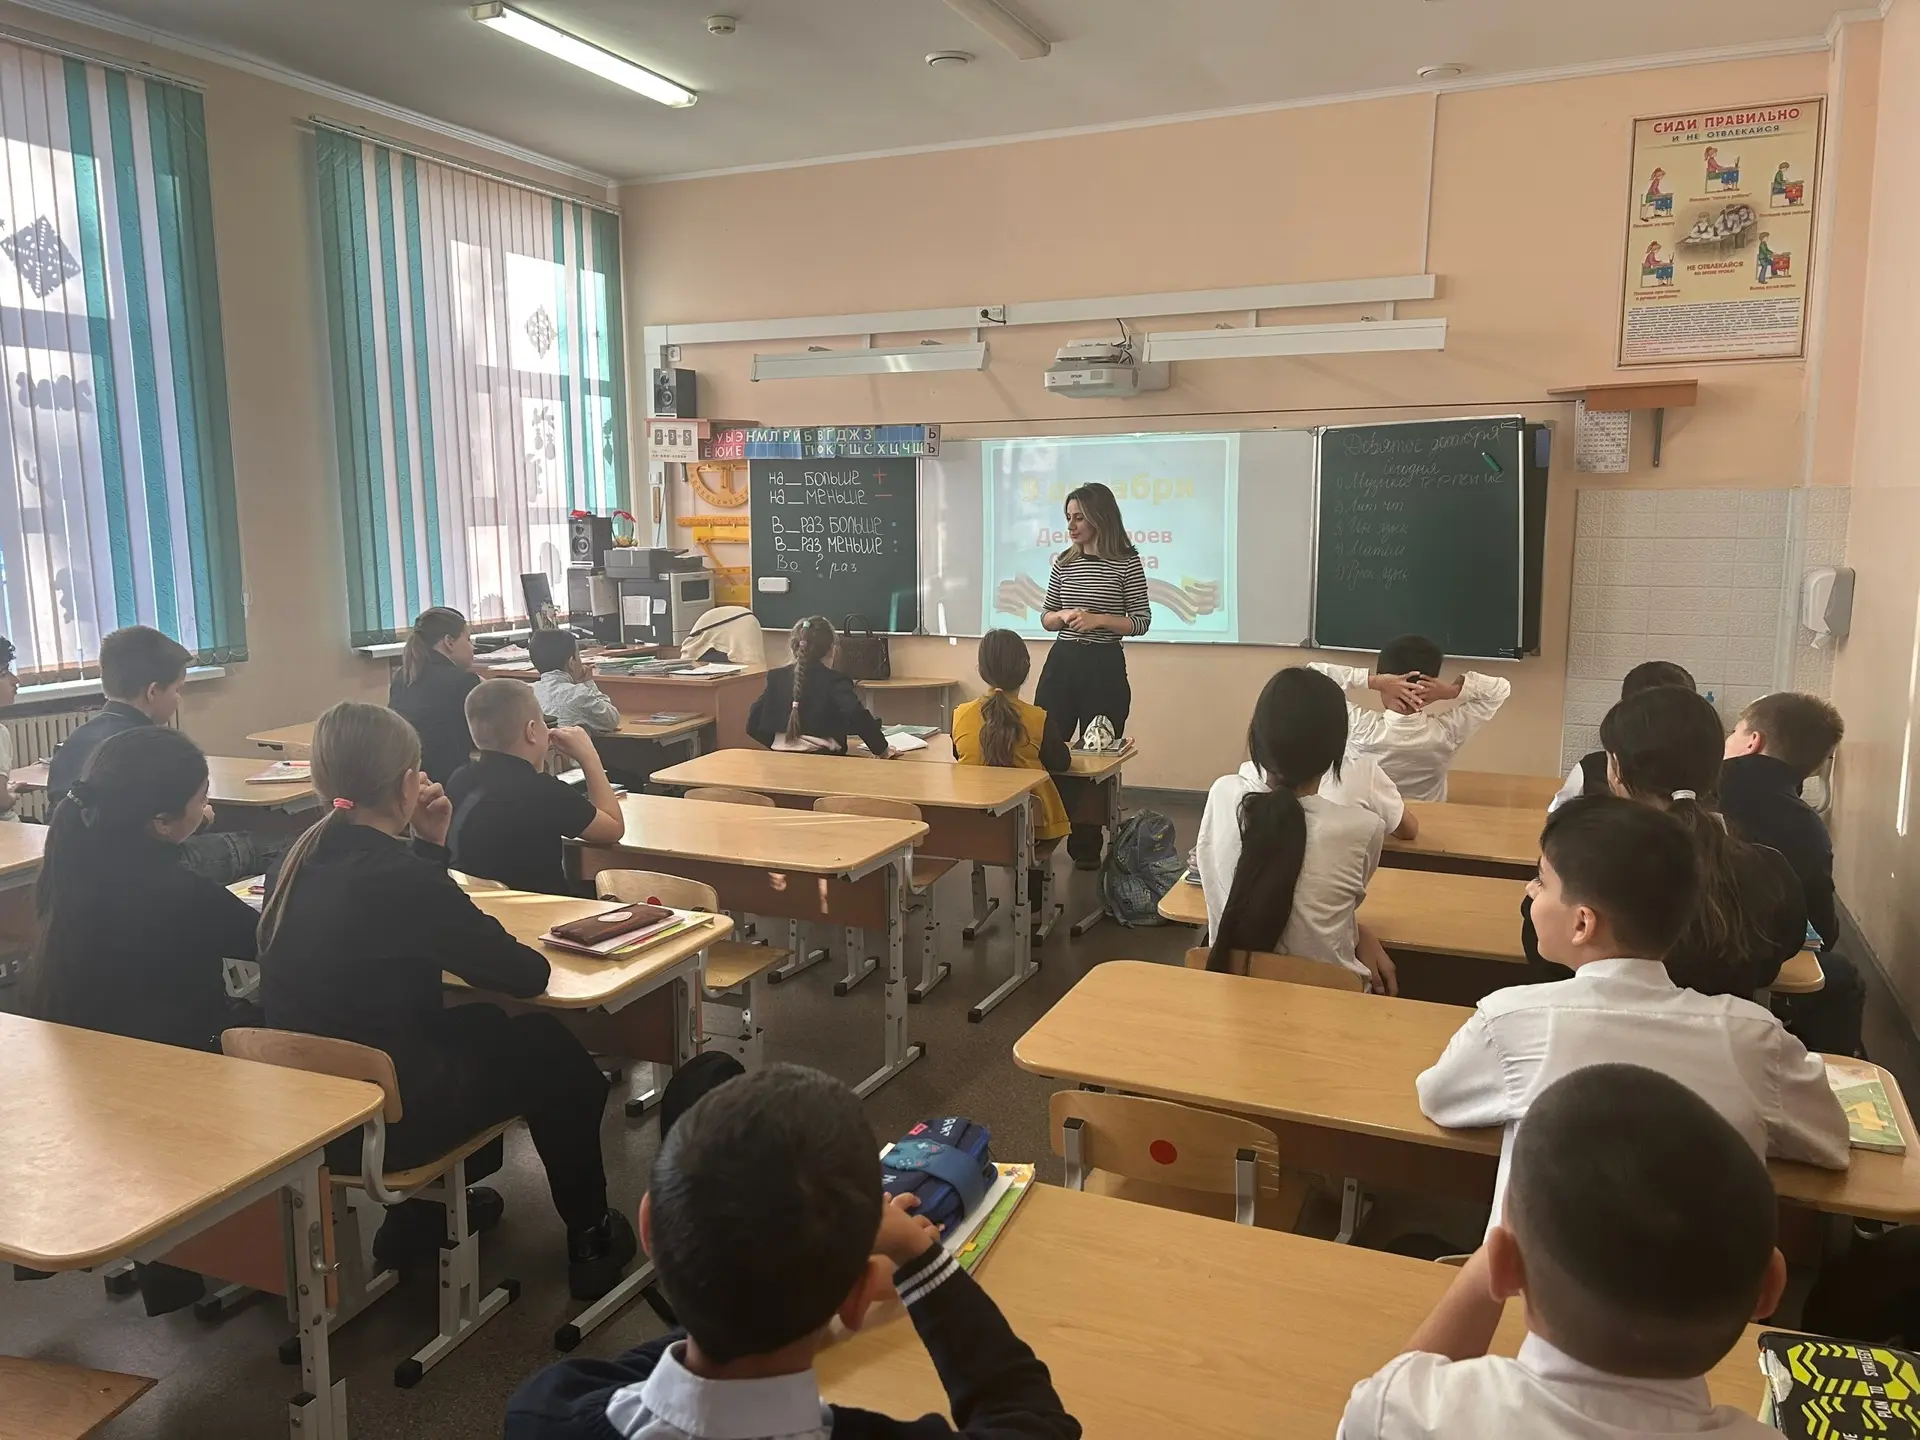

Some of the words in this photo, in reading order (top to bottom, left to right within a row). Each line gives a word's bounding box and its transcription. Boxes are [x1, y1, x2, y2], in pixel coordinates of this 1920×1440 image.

[1653, 119, 1698, 133] СИДИ
[1704, 108, 1801, 128] ПРАВИЛЬНО
[1686, 133, 1700, 141] НЕ
[1706, 125, 1781, 138] ОТВЛЕКАЙСЯ
[1697, 261, 1744, 270] ОТВЛЕКАЙСЯ
[769, 471, 784, 485] на
[800, 516, 825, 534] раз
[801, 536, 822, 553] раз
[777, 554, 799, 571] Во
[829, 562, 857, 579] раз
[1845, 1101, 1889, 1131] 4
[1873, 1400, 1893, 1419] PLAN
